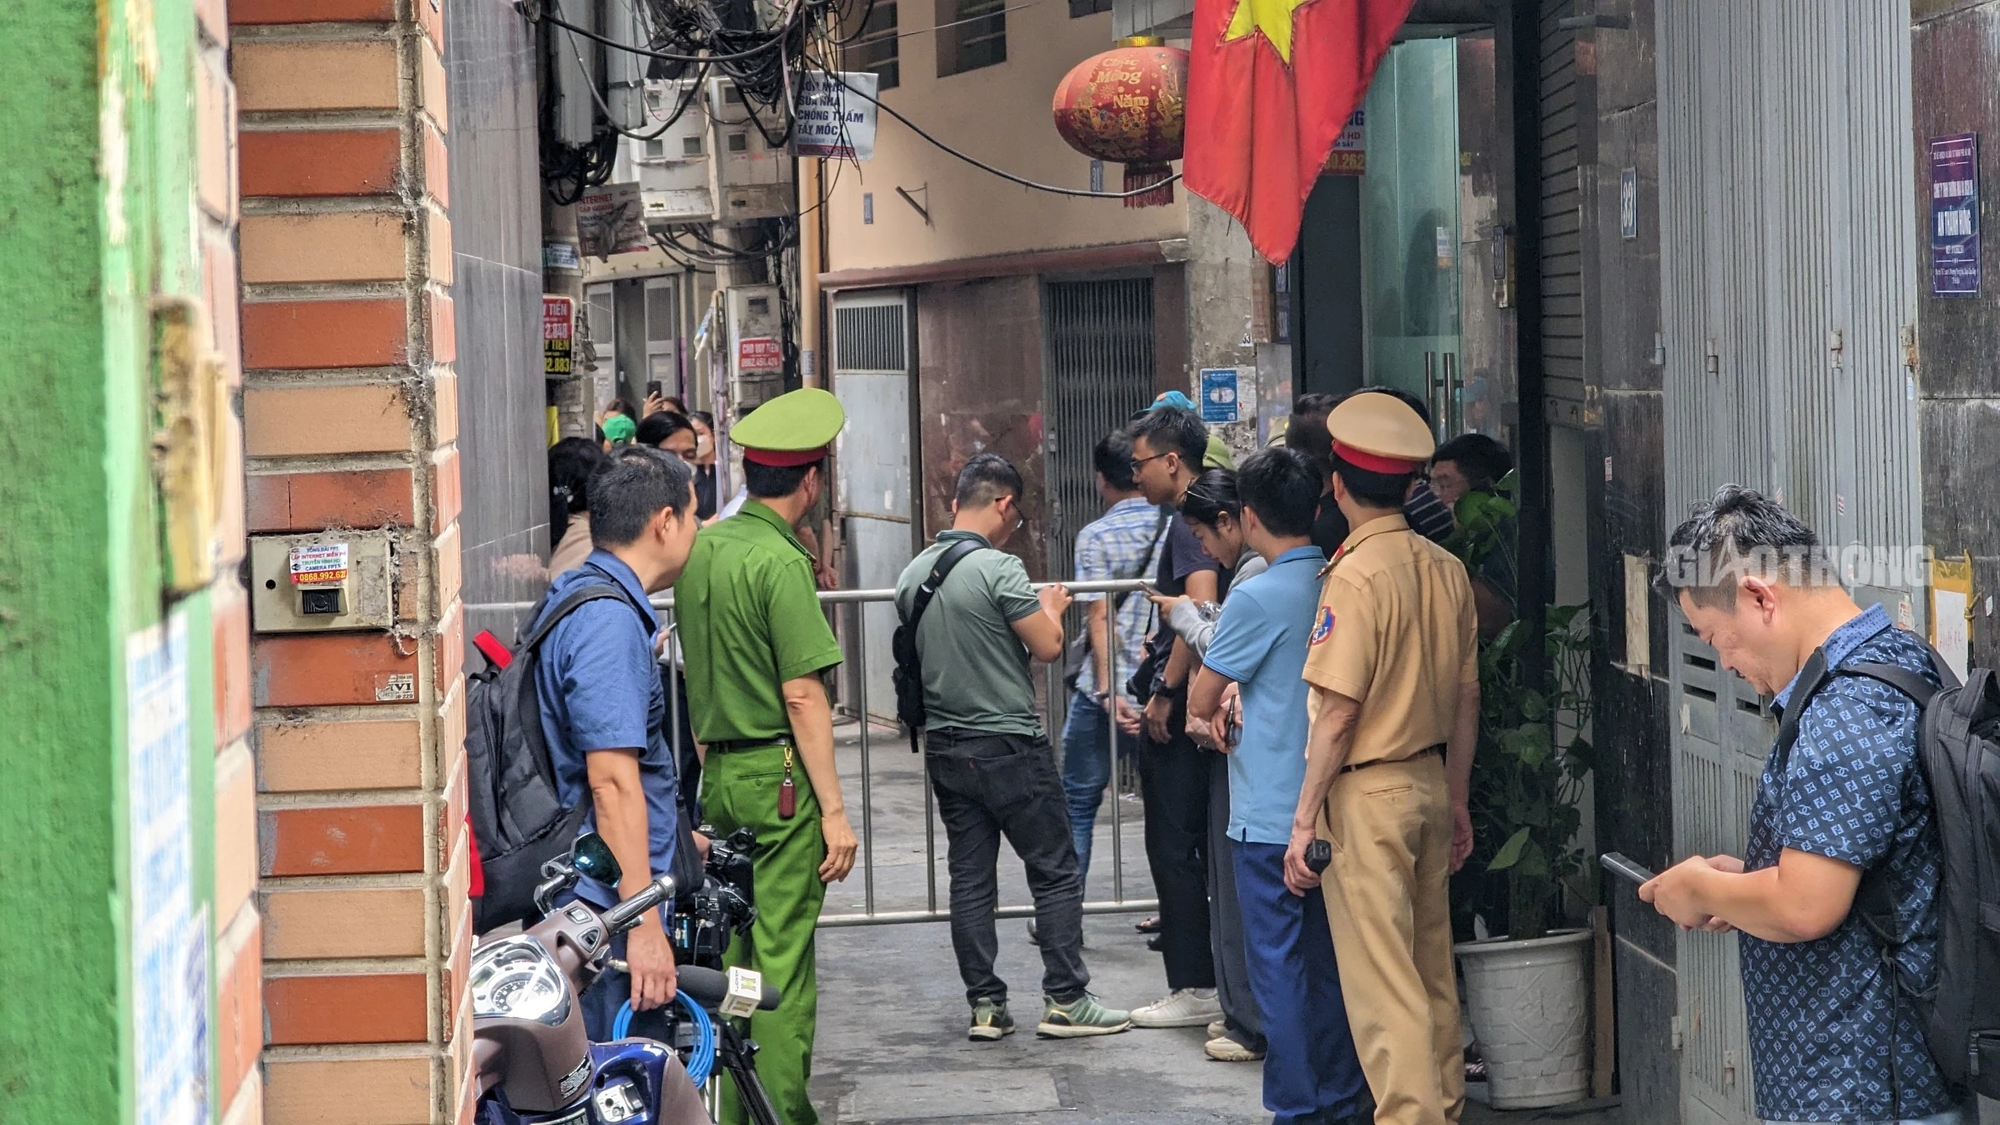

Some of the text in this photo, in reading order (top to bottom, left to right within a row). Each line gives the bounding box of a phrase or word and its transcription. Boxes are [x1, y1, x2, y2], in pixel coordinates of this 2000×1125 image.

[1113, 94, 1149, 108] Năm
[798, 107, 829, 120] CHỐNG
[815, 122, 838, 135] MỐC
[581, 194, 613, 204] NTERNET
